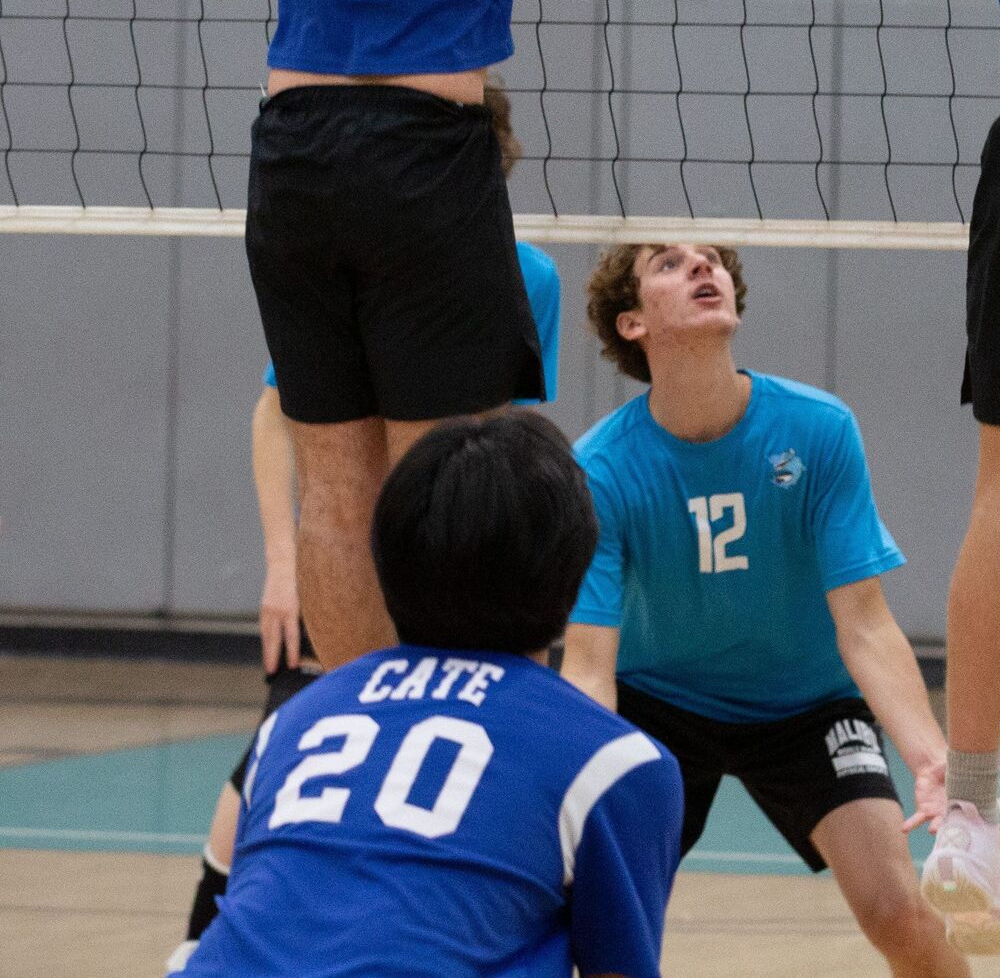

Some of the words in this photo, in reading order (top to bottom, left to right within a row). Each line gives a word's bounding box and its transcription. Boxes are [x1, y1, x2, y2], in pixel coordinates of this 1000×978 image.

[688, 492, 749, 574] 12
[358, 657, 505, 706] CATE
[268, 714, 494, 839] 20
